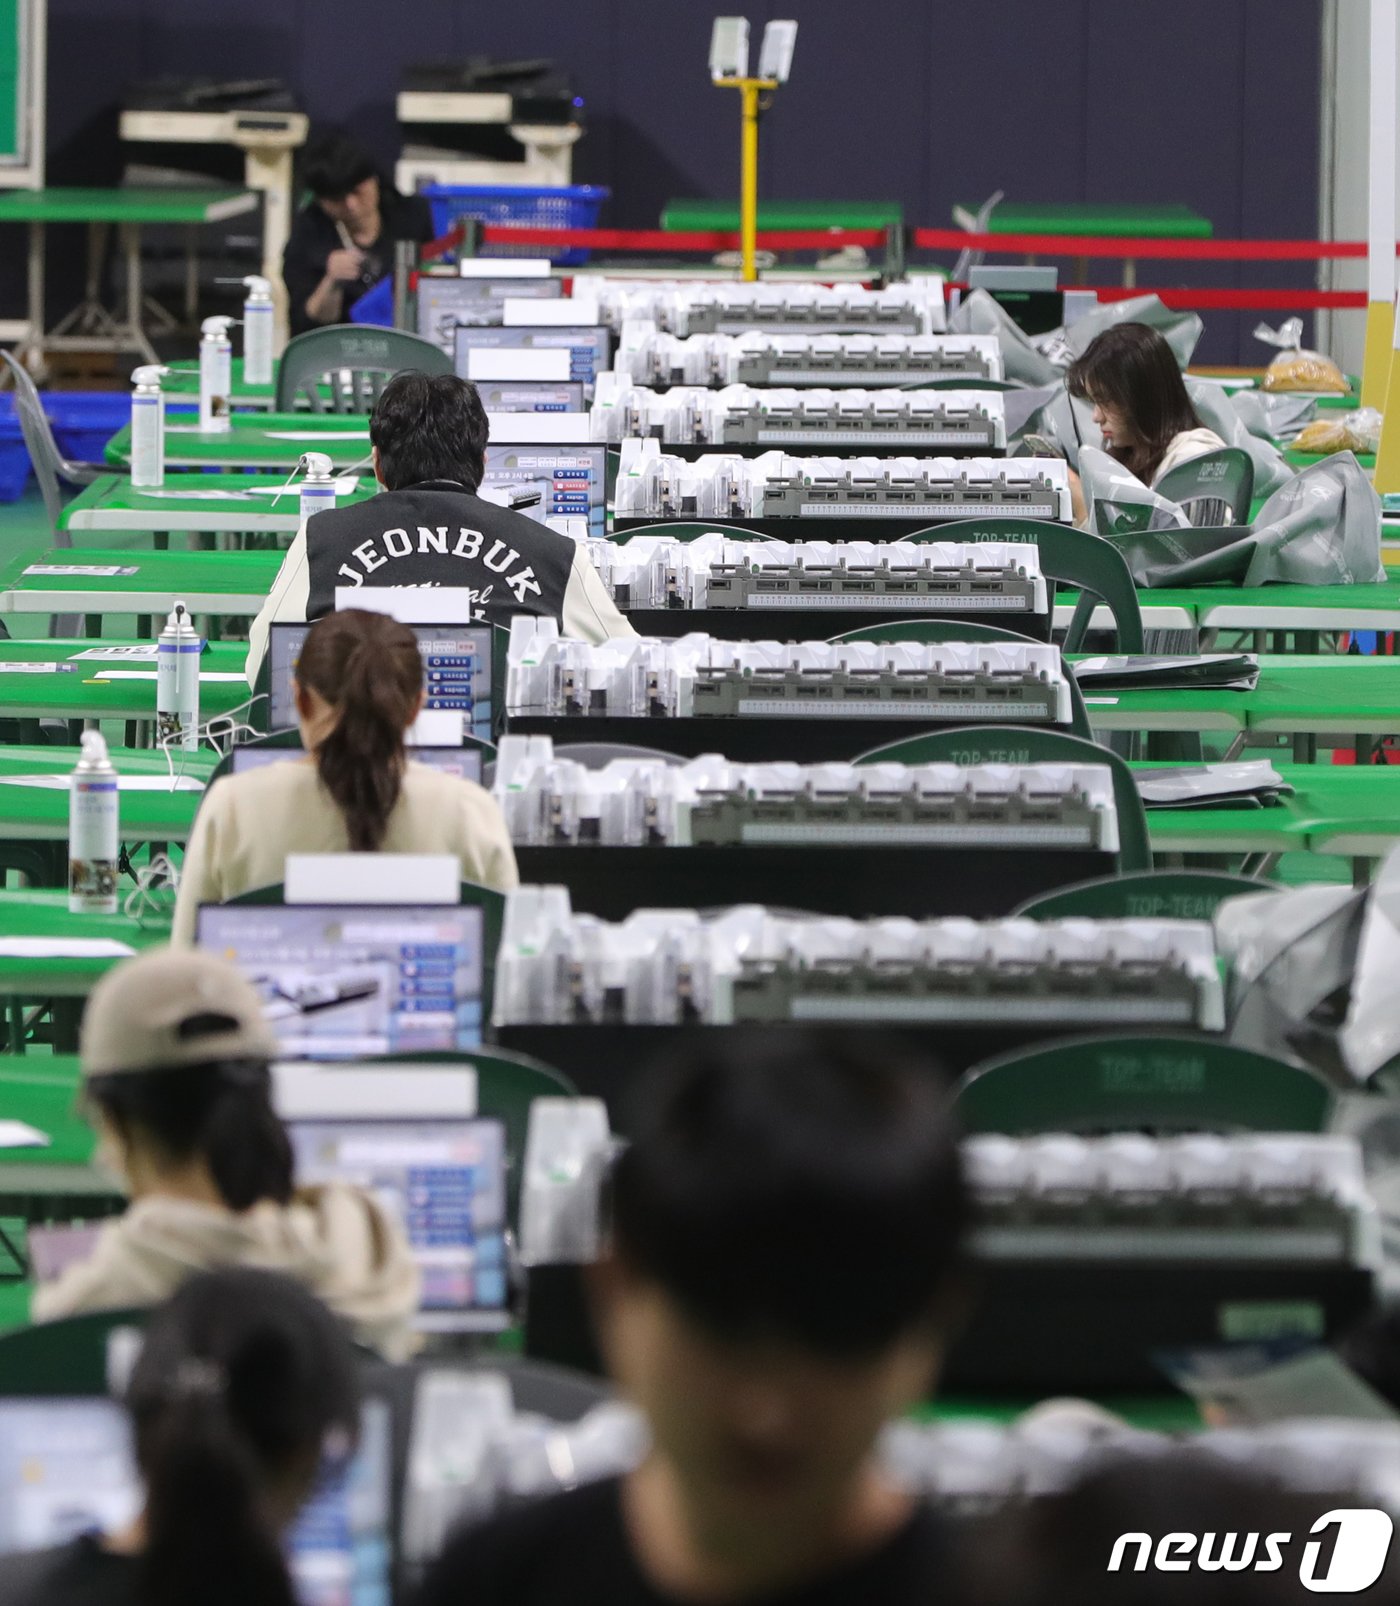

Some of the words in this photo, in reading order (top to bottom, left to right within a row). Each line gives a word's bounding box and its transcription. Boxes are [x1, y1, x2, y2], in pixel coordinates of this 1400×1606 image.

[973, 532, 1039, 544] TOP-TEAM
[337, 526, 542, 604] JEONBUK
[951, 749, 1030, 766] TOP-TEAM
